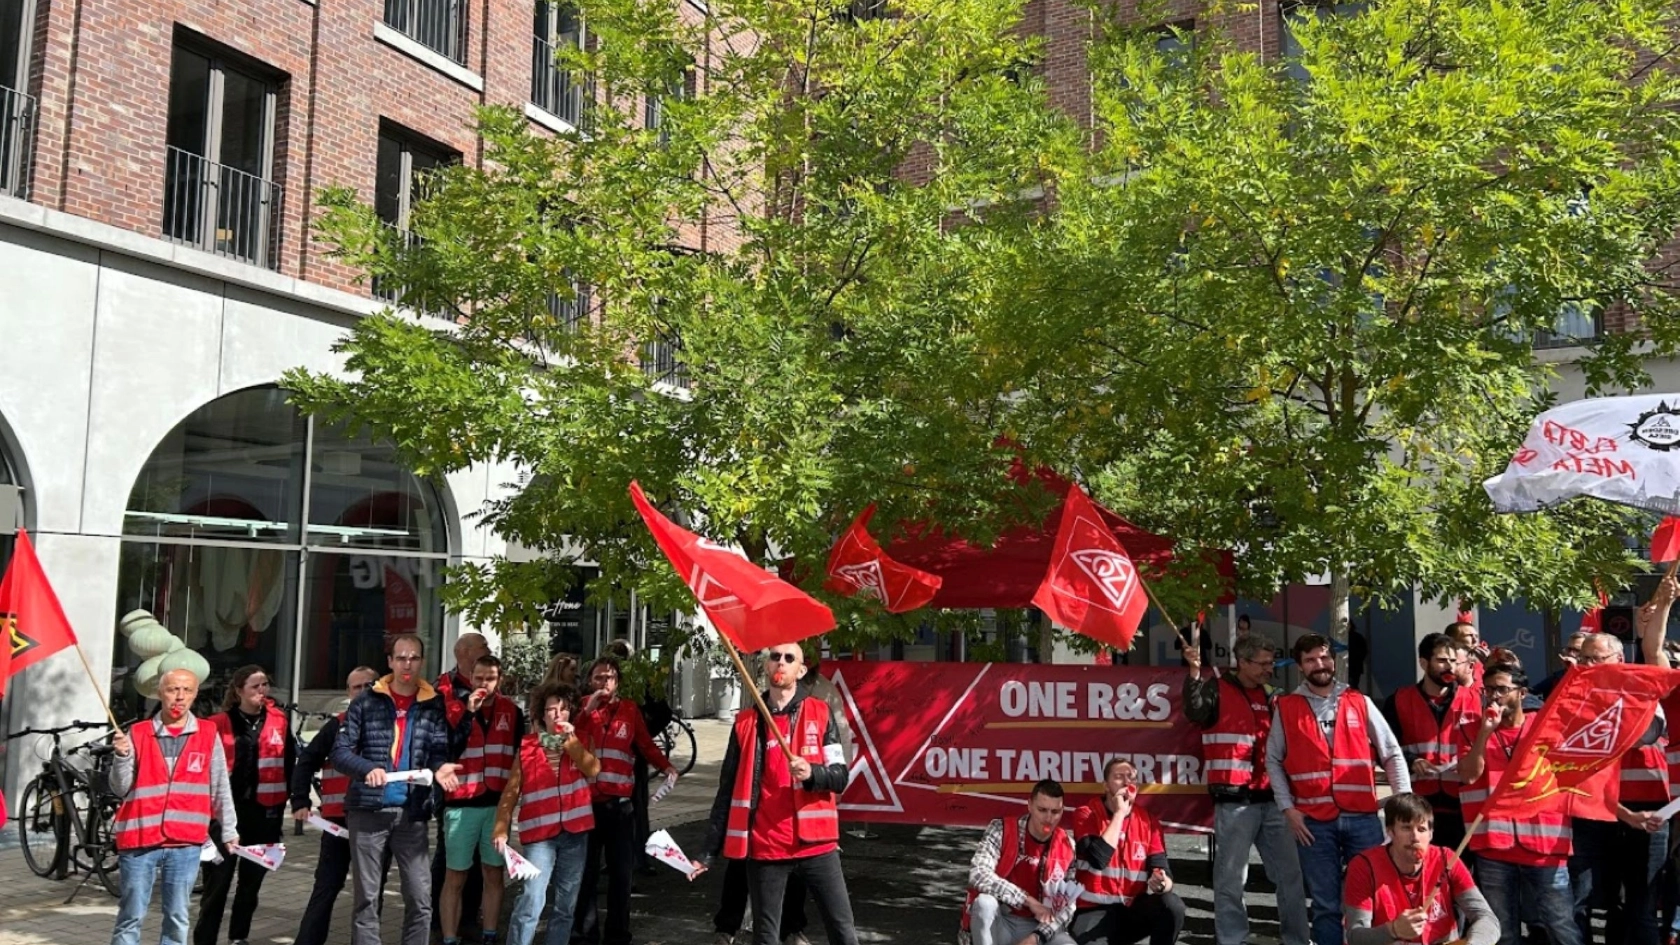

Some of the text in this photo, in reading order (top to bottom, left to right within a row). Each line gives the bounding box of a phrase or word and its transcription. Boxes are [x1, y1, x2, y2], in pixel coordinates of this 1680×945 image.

[1000, 680, 1171, 721] ONE R&S
[925, 746, 1209, 785] ONE TARIFVRTR
